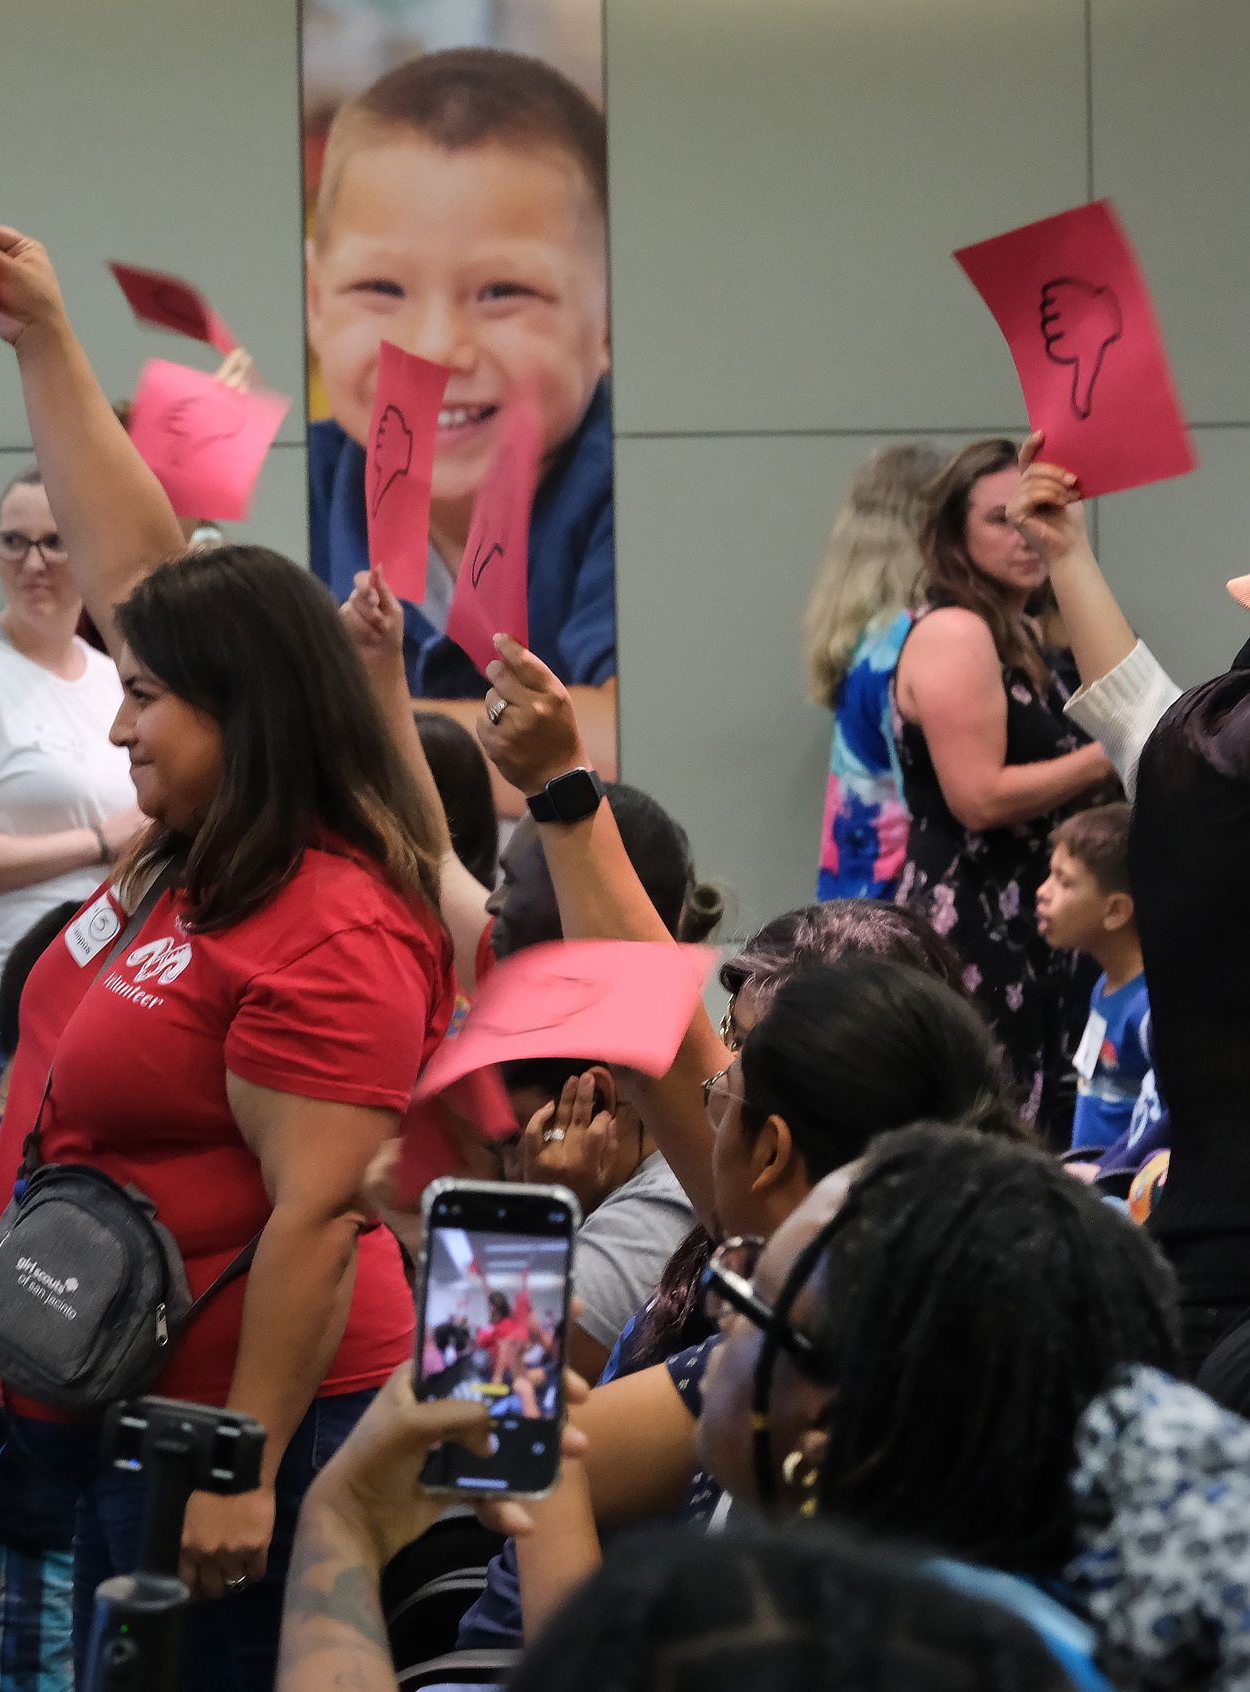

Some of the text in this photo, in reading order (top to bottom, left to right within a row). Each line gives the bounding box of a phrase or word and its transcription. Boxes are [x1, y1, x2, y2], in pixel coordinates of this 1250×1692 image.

[15, 1257, 65, 1295] girl scouts
[17, 1274, 77, 1320] of san jacinto
